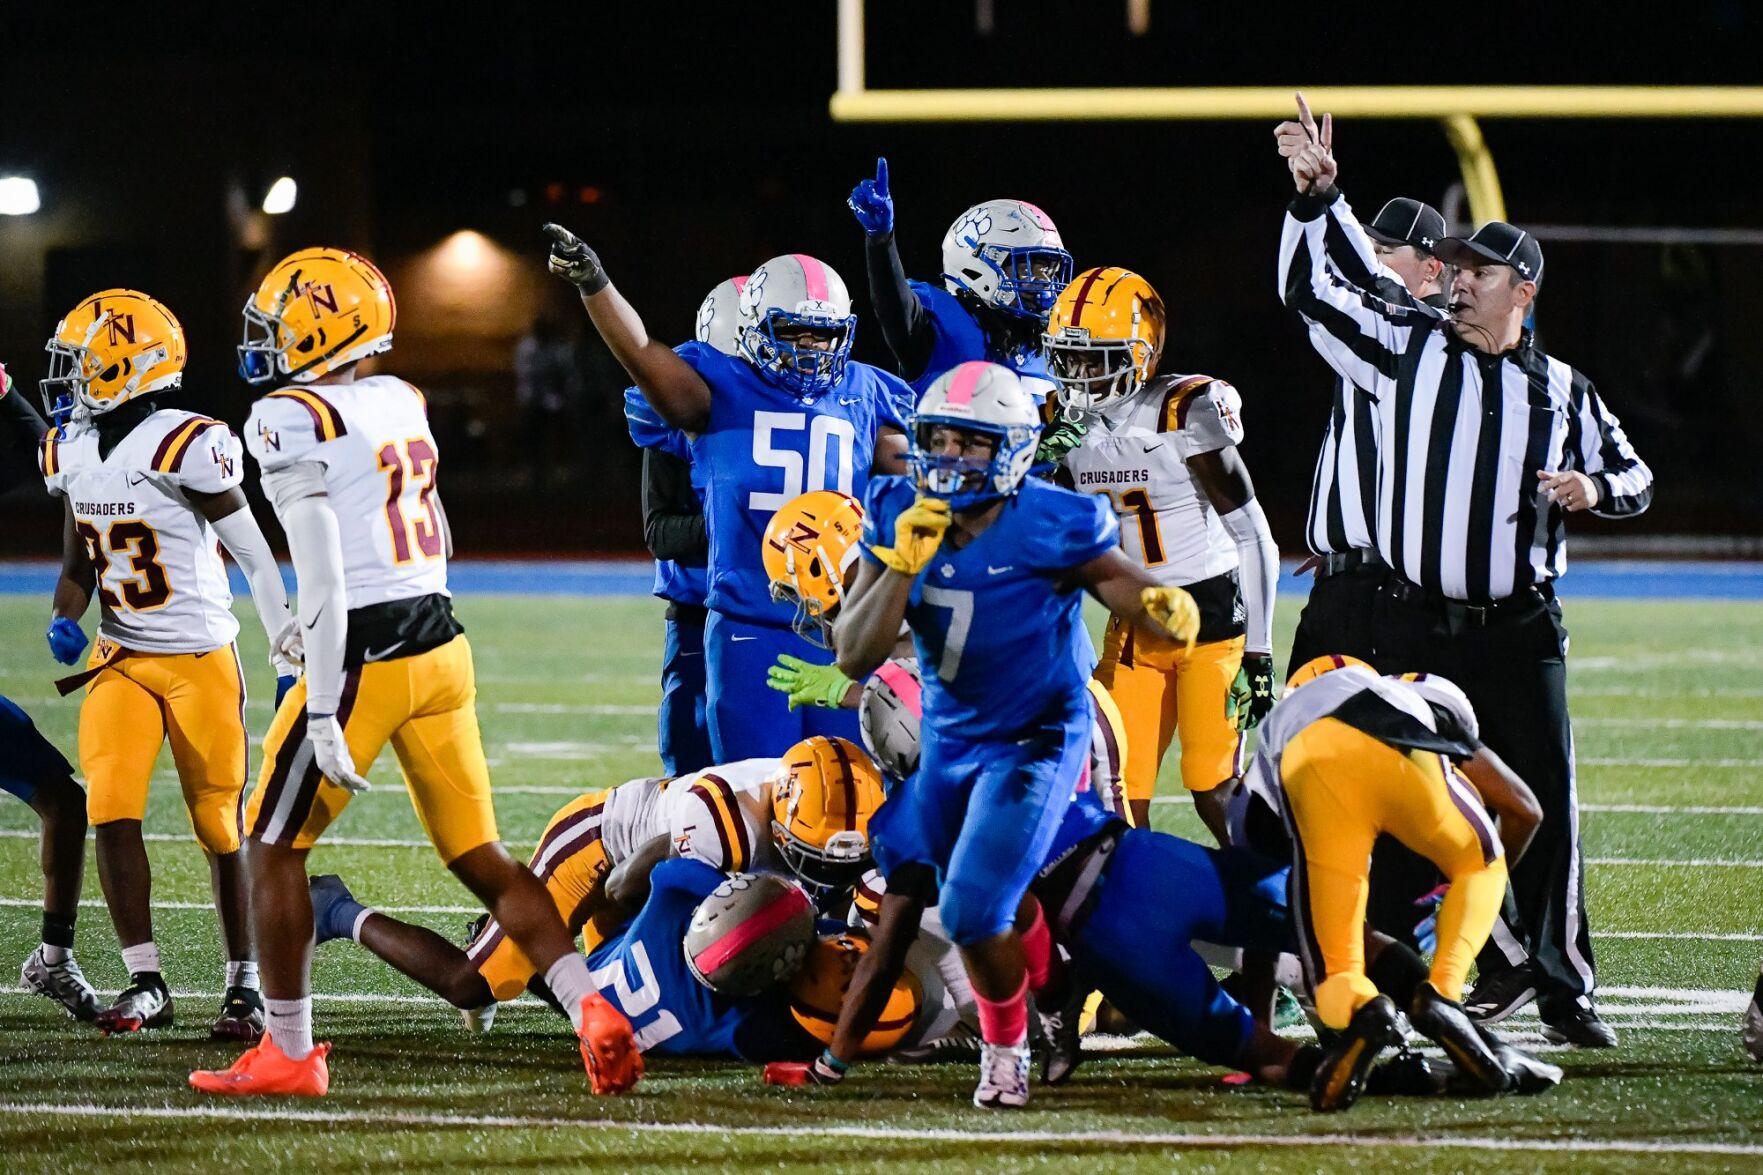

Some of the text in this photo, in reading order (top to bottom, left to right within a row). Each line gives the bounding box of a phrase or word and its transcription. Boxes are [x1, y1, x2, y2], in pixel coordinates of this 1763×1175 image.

[75, 502, 135, 516] CRUSADERS
[376, 436, 442, 565] 13
[749, 410, 855, 511] 50
[1080, 469, 1149, 485] CRUSADERS
[923, 584, 974, 683] 7
